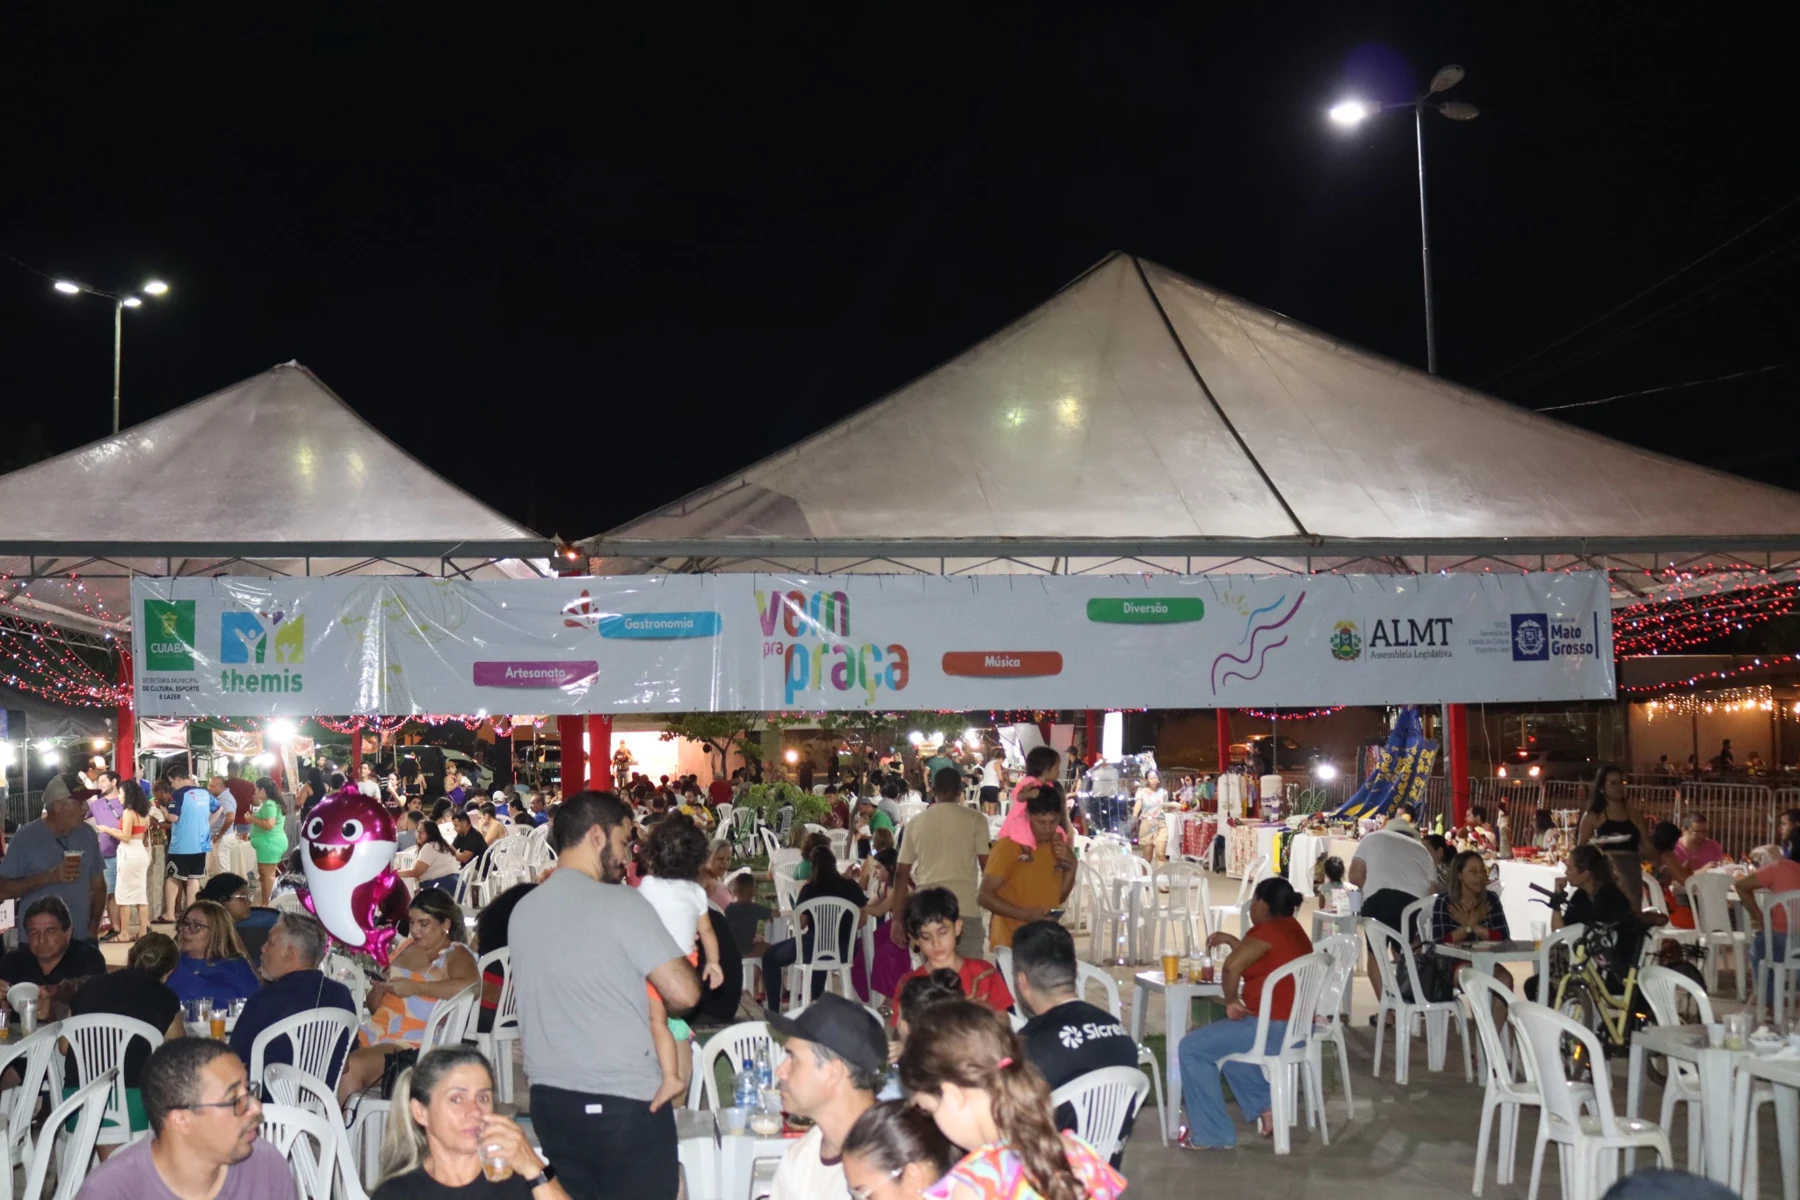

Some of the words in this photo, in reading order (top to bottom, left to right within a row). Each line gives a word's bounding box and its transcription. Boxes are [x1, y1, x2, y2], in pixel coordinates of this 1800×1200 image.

[755, 590, 850, 637] vem
[1123, 602, 1169, 614] Diversão
[624, 617, 694, 629] Gastronomia
[1369, 617, 1453, 647] ALMT
[1551, 624, 1581, 639] Mato
[763, 641, 784, 659] pra
[1370, 650, 1412, 659] Assembleia
[1414, 649, 1453, 660] Legislativa
[1552, 640, 1593, 656] Grosso
[984, 655, 1021, 668] Música
[505, 666, 566, 678] Artesanato
[784, 643, 909, 706] praça
[221, 668, 303, 693] themis
[150, 685, 174, 693] CULTURA,
